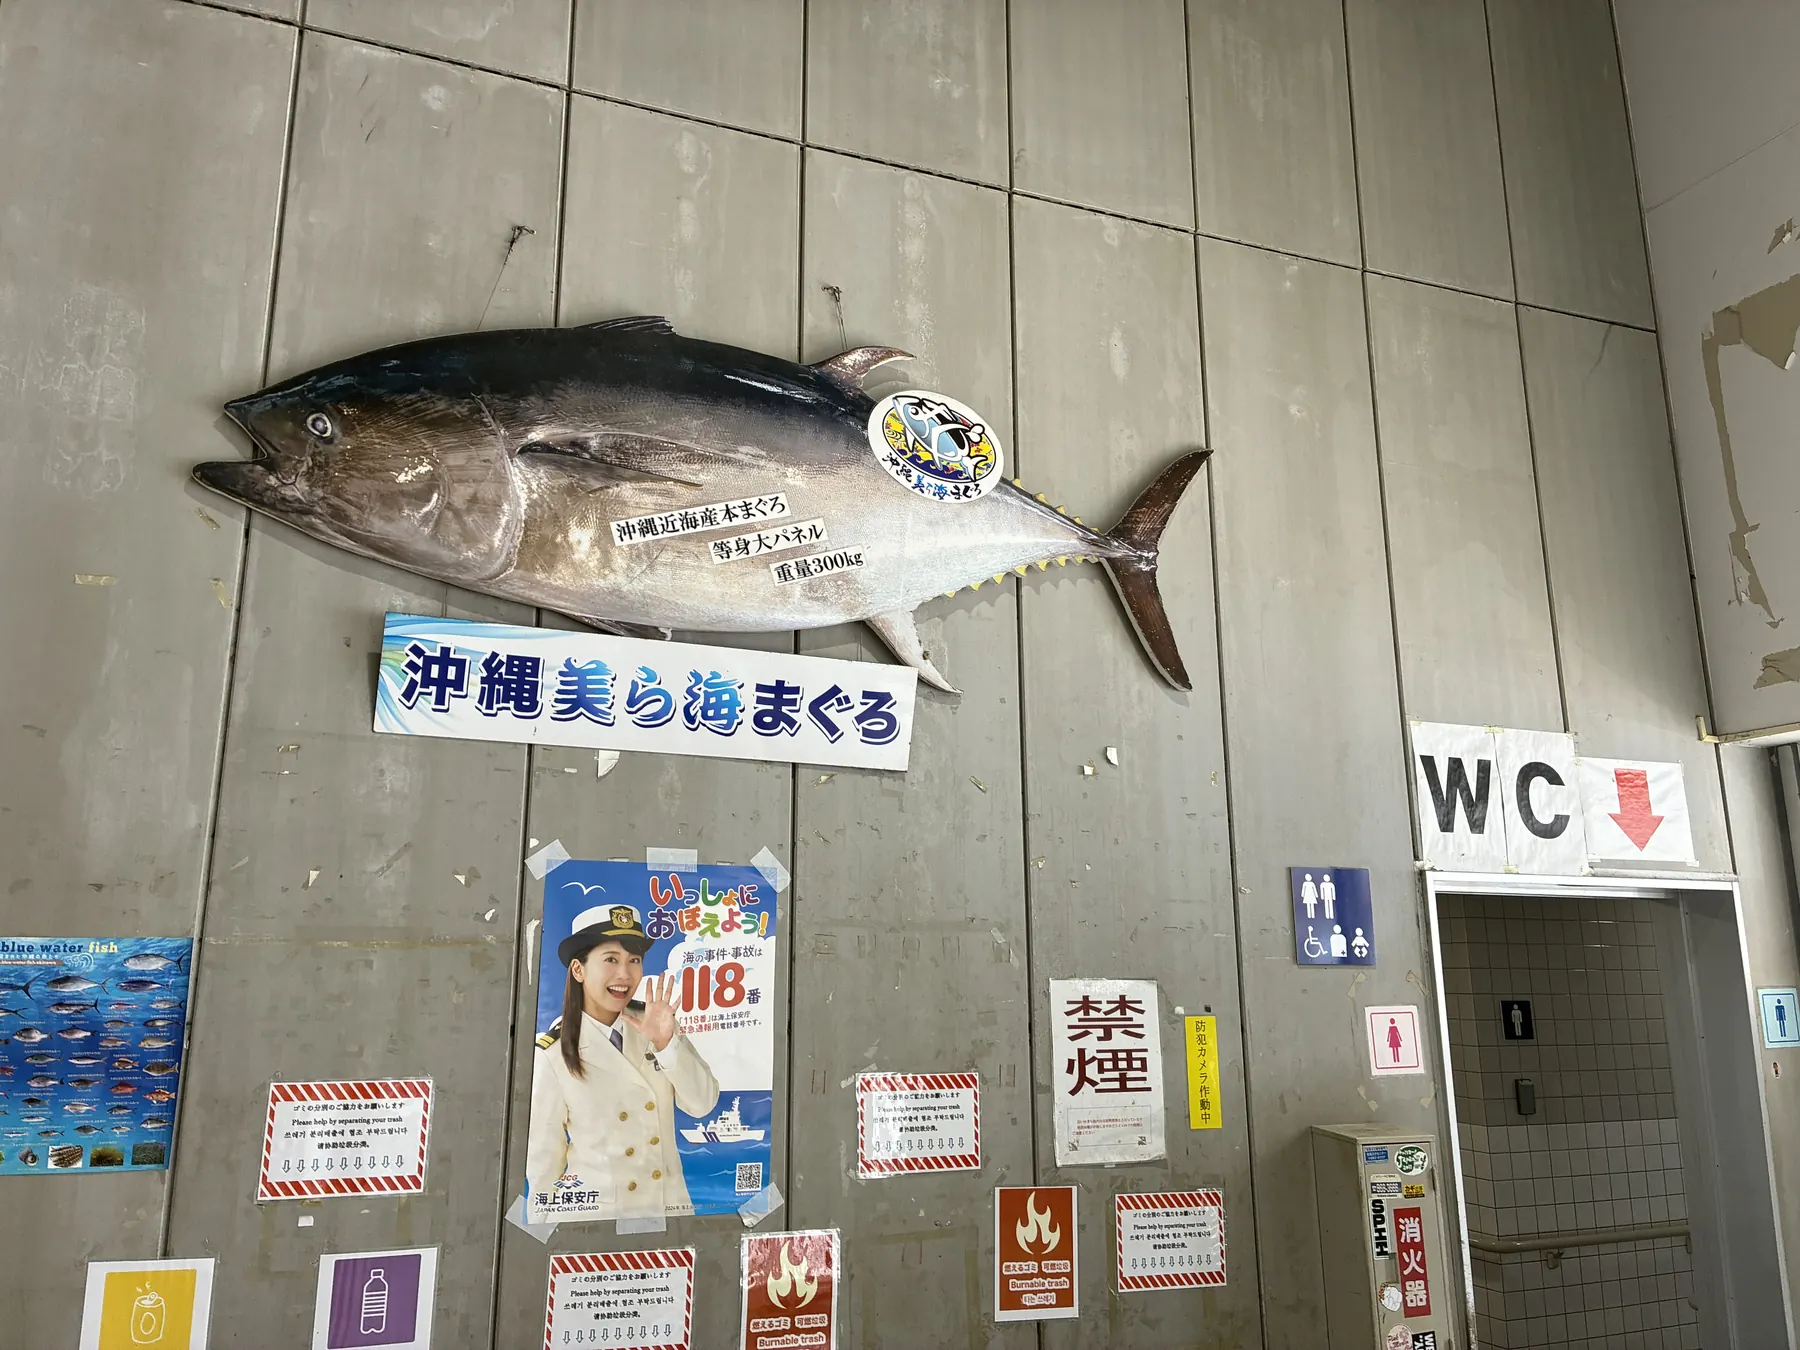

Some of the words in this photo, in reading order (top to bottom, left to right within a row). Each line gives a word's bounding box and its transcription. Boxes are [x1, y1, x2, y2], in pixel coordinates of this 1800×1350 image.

[616, 495, 785, 541] 沖縄近海産本まぐろ
[712, 524, 824, 560] 等身大パネル
[774, 551, 864, 583] 重量300kg
[400, 641, 901, 745] 沖縄美ら海まぐろ
[650, 873, 759, 906] いっしょに
[647, 906, 769, 939] おぼえよう!
[1, 942, 34, 953] blue
[40, 943, 84, 953] water
[88, 942, 118, 953] fish
[1064, 994, 1152, 1096] 禁煙
[1195, 1020, 1211, 1124] 防犯カメラ作動中
[313, 1118, 328, 1127] help
[328, 1118, 337, 1126] by
[338, 1117, 370, 1126] separating
[535, 1190, 599, 1206] 海上保安庁
[1004, 1263, 1036, 1273] 燃えるゴミ
[1398, 1216, 1427, 1307] 消火器
[590, 1289, 602, 1298] help
[603, 1288, 611, 1297] by
[612, 1286, 641, 1296] separating
[1010, 1280, 1046, 1289] Burnable
[1047, 1279, 1068, 1287] trash
[752, 1318, 789, 1330] 燃えるゴミ
[759, 1336, 799, 1347] Burnable
[801, 1335, 824, 1343] trash
